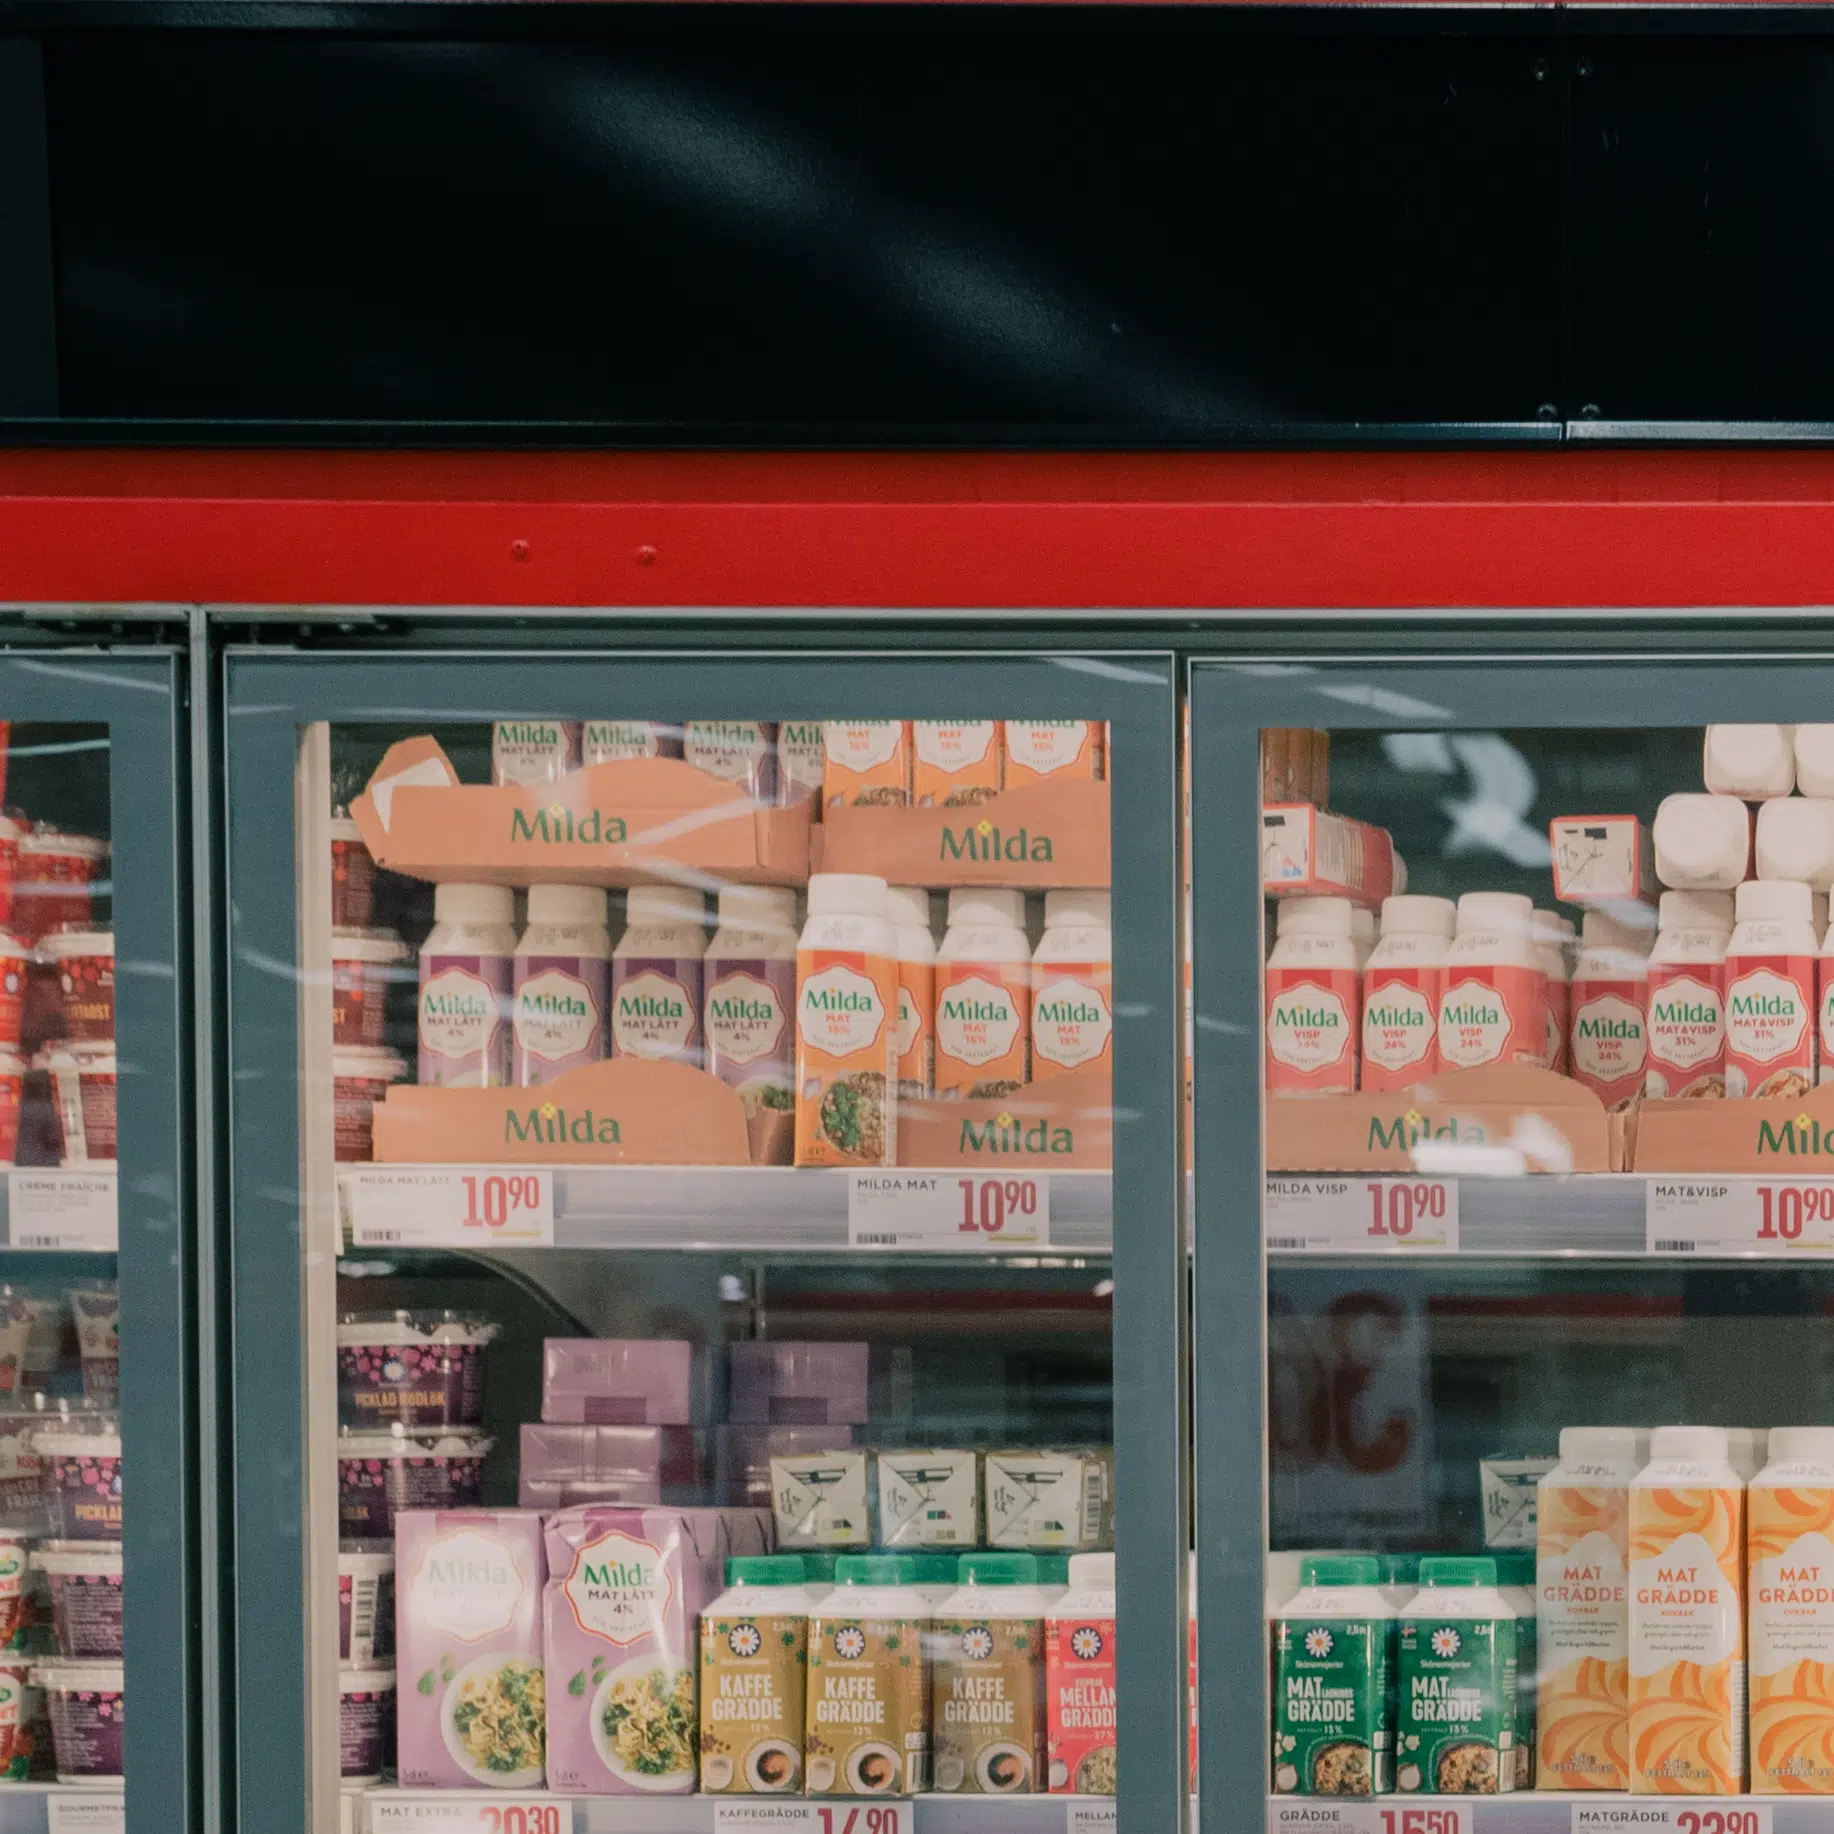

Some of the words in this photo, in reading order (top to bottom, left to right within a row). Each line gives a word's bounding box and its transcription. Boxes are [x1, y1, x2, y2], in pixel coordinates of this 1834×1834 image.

[511, 806, 627, 844] Milda
[940, 823, 1053, 861] Milda
[620, 995, 682, 1017] Milda
[711, 997, 773, 1020] Milda
[806, 989, 872, 1011] Milda
[944, 998, 1008, 1021] Milda
[1655, 1000, 1717, 1023] Milda
[1732, 993, 1794, 1016] Milda
[1368, 1006, 1424, 1027] Milda
[1579, 1018, 1640, 1039] Milda
[505, 1106, 621, 1144] Milda
[959, 1115, 1073, 1153] Milda
[1368, 1112, 1485, 1153] Milda
[461, 1176, 540, 1227] 1090
[1655, 1185, 1728, 1198] MAT&VISP
[857, 1180, 901, 1190] MILDA
[908, 1180, 937, 1190] MAT
[958, 1180, 1037, 1232] 1090
[1267, 1183, 1312, 1195] MILDA
[1317, 1182, 1348, 1194] VISP
[1367, 1183, 1445, 1236] 1090
[582, 1561, 653, 1589] Milda
[1657, 1568, 1697, 1583] MAT
[1638, 1585, 1718, 1604] GRÄDDE
[720, 1674, 773, 1697] KAFFE
[712, 1694, 783, 1720] GRÄDDE
[720, 1807, 809, 1819] KAFFEGRÄDDE
[1280, 1809, 1341, 1822] GRÄDDE
[1579, 1809, 1669, 1823] MATGRÄDDE
